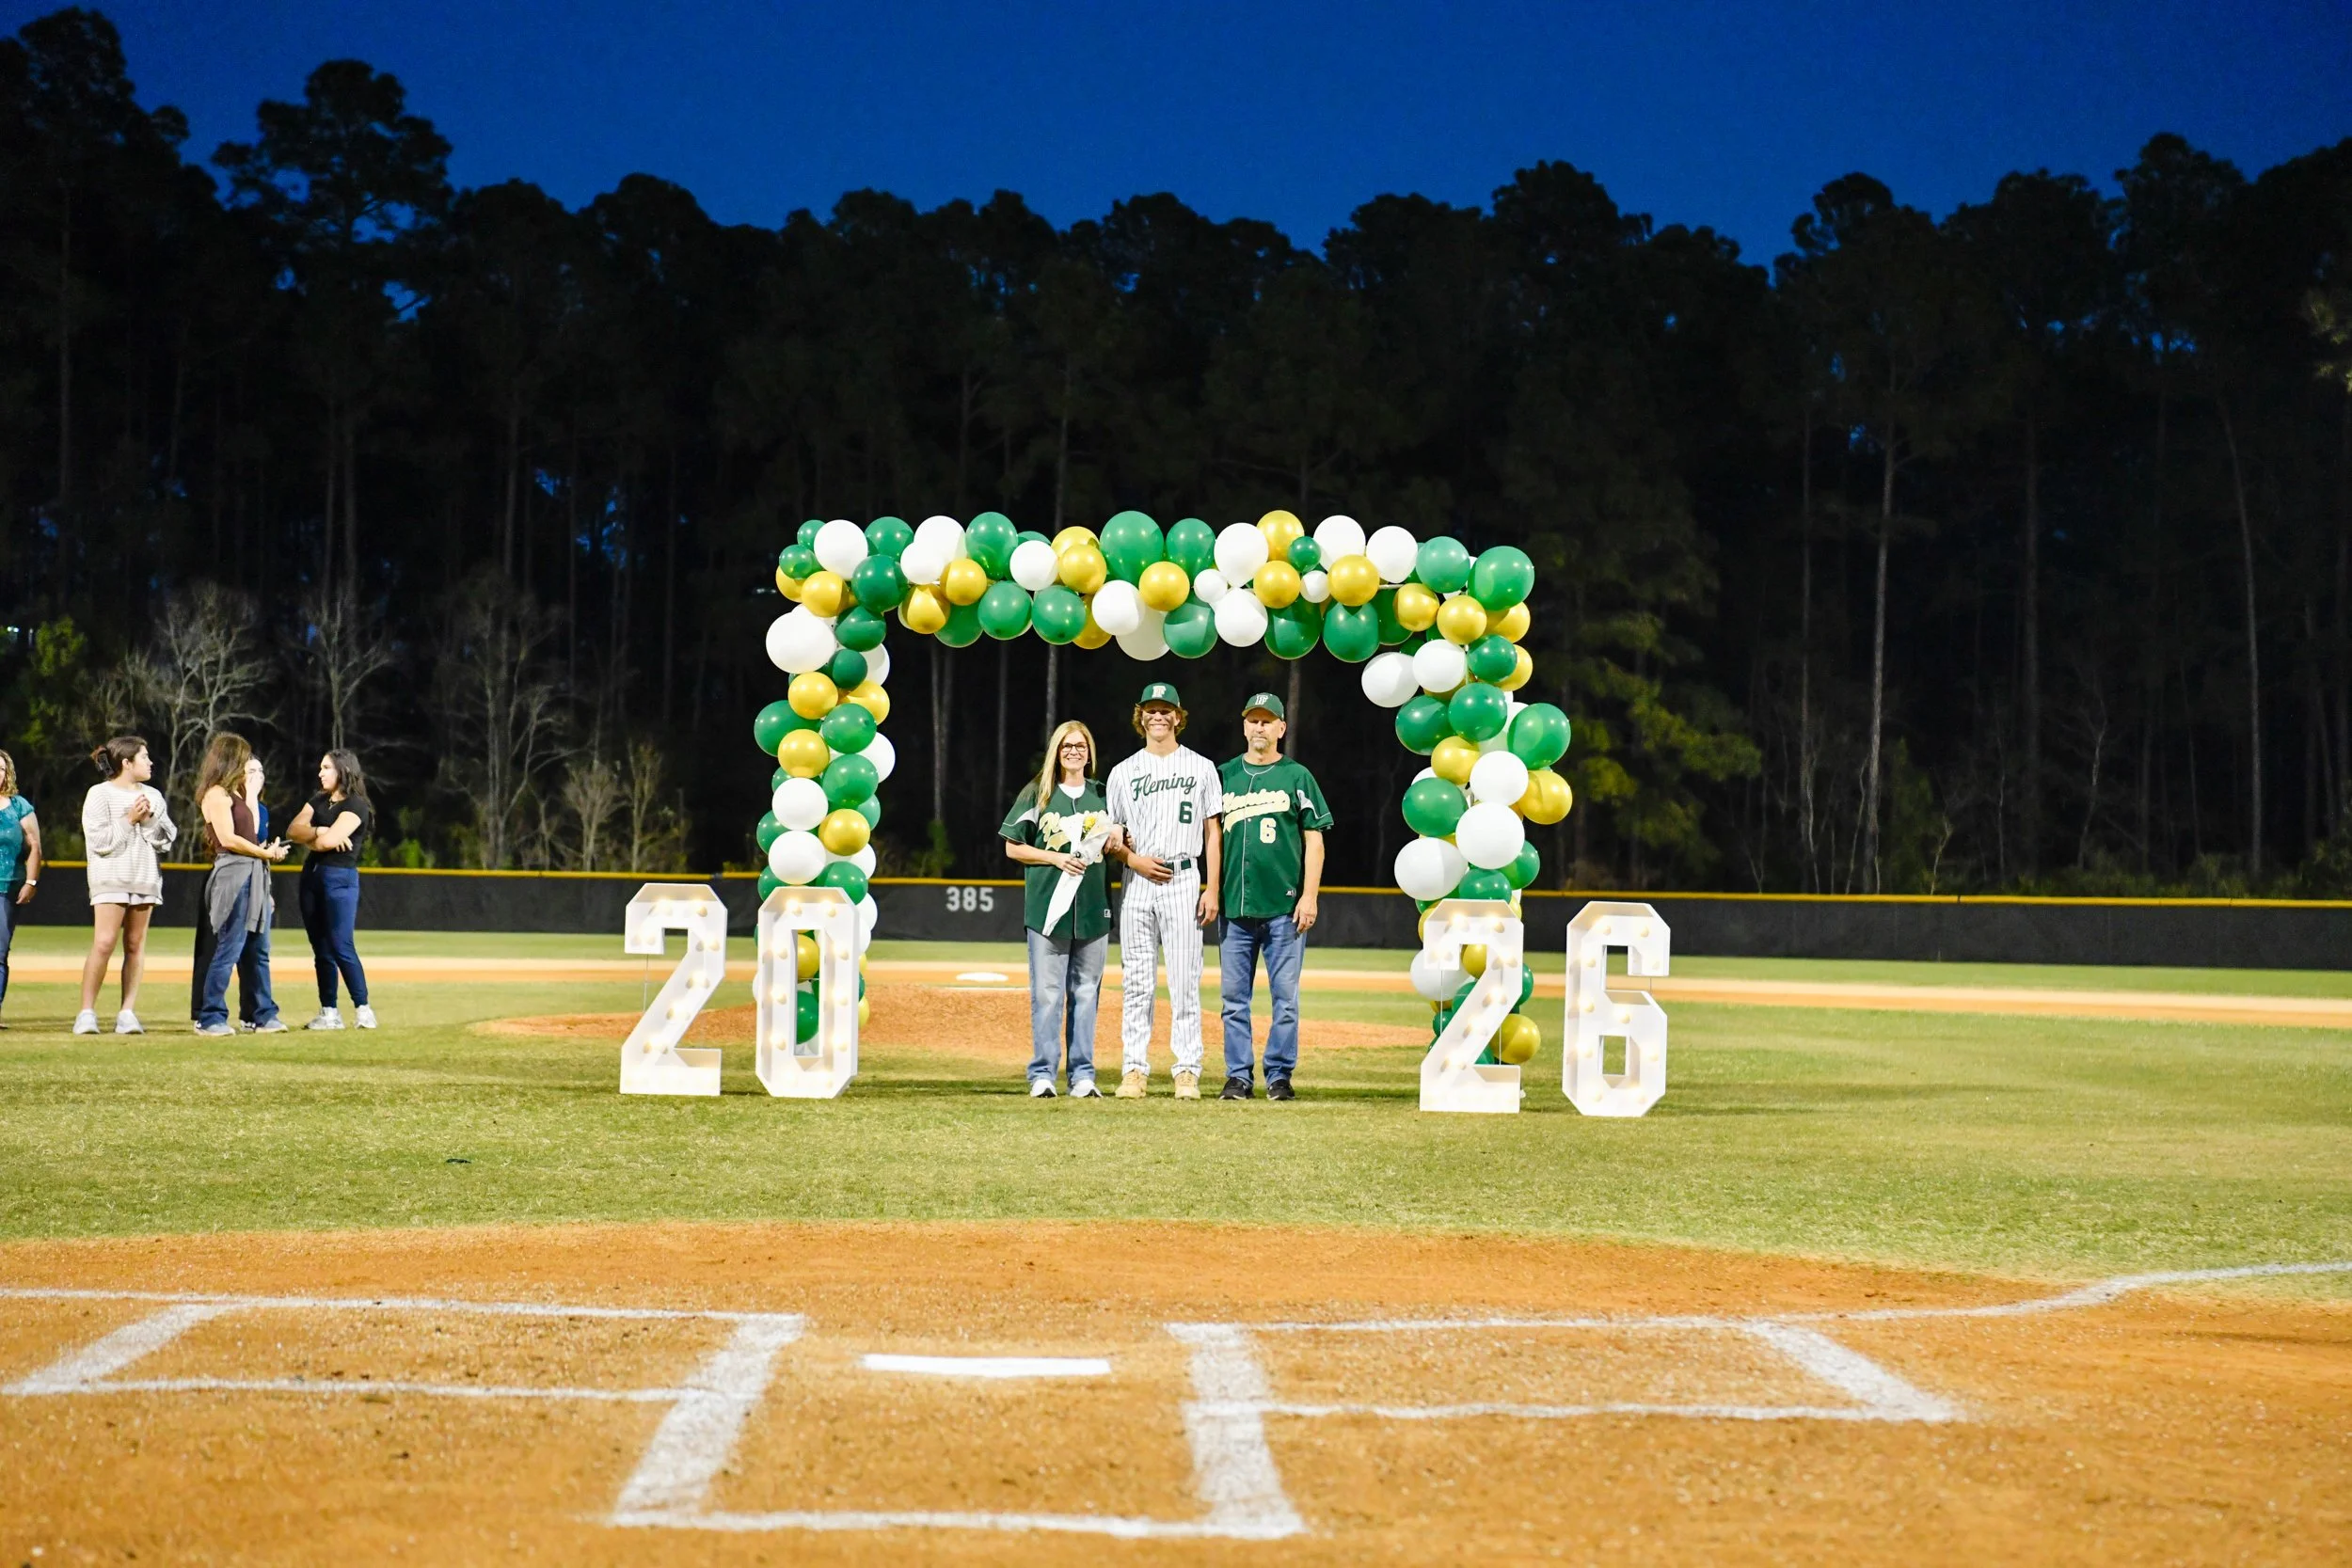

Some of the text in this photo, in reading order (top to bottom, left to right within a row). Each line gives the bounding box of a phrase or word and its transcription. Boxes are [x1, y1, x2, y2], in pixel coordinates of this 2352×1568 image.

[1130, 772, 1198, 801] Fleming
[1179, 800, 1193, 824] 6
[1259, 817, 1277, 844] 6
[946, 886, 994, 911] 385
